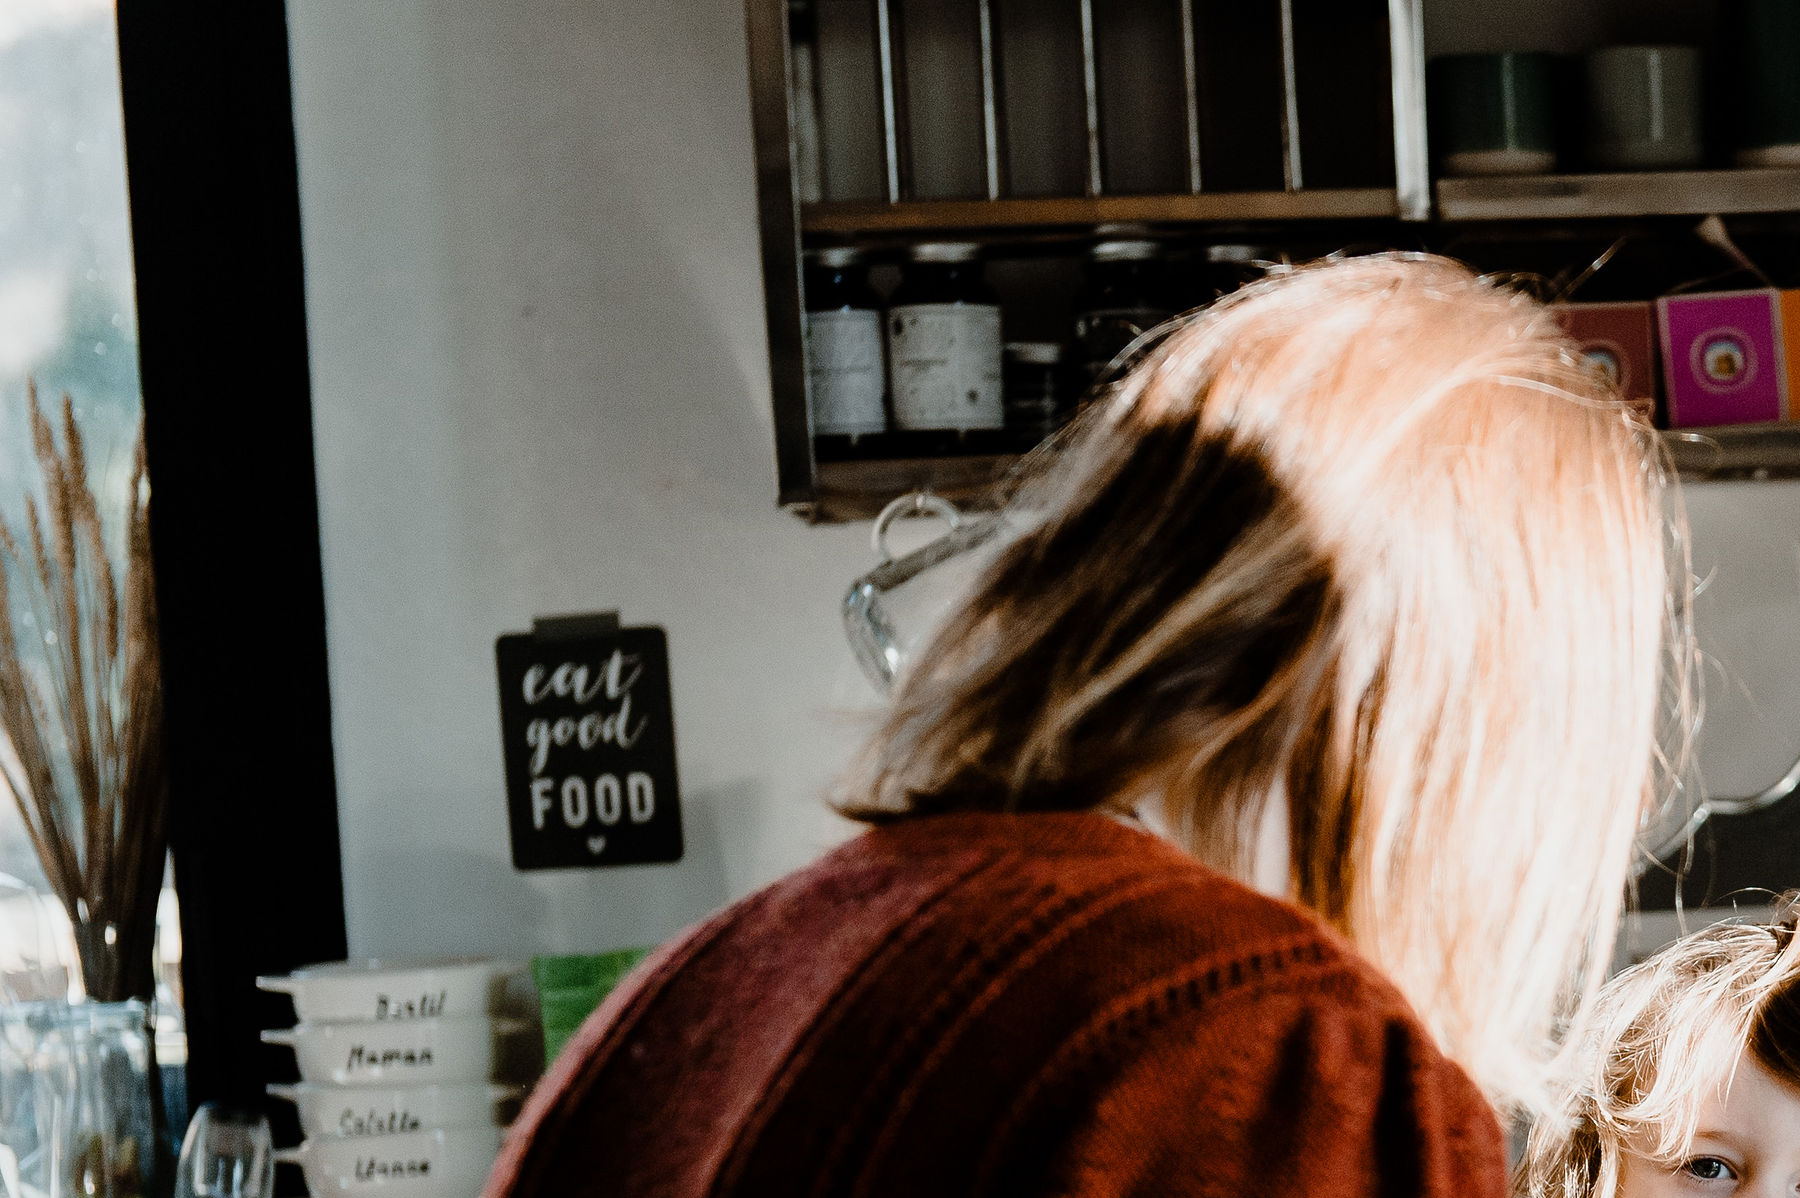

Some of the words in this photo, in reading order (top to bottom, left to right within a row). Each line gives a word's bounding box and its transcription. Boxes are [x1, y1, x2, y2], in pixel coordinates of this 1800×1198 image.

[522, 649, 645, 704] eat
[526, 693, 649, 778] good
[530, 772, 655, 831] FOOD
[346, 1044, 433, 1072] Maman
